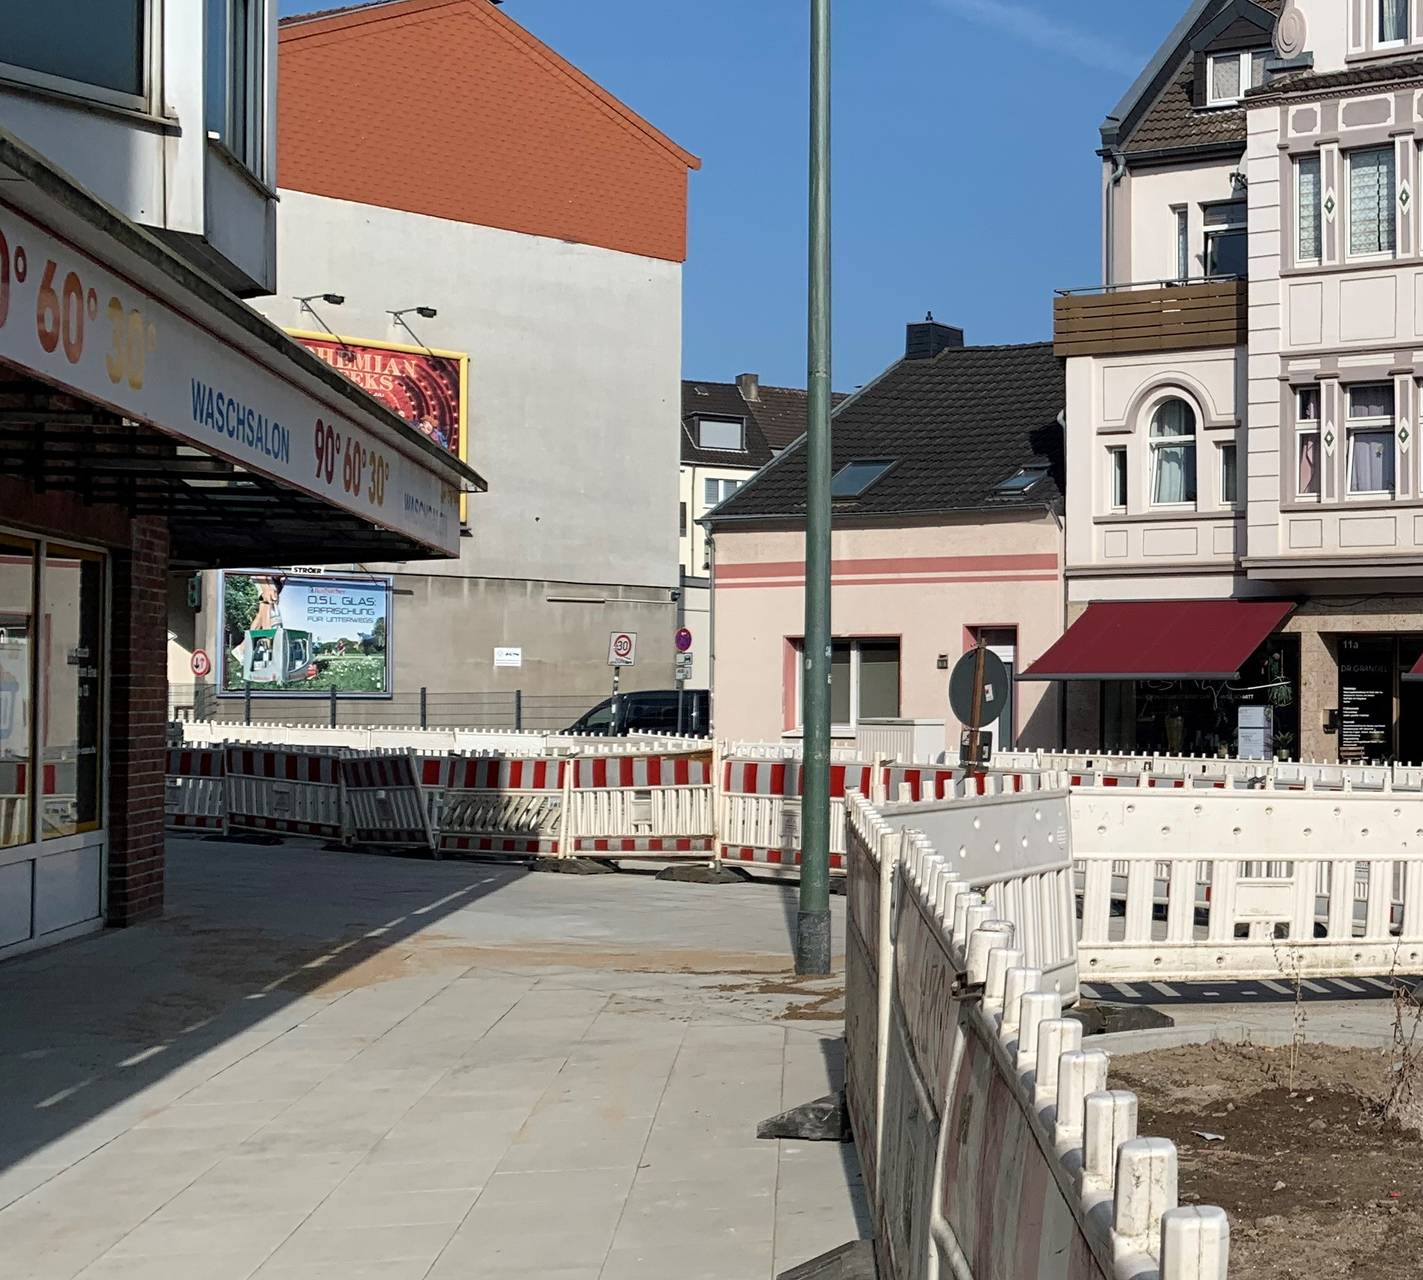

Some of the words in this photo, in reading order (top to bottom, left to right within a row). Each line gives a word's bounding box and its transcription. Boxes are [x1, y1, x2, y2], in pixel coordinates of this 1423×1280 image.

[36, 259, 98, 365] 60°
[191, 377, 290, 464] WASCHSALON
[314, 418, 341, 485] 90°
[343, 437, 367, 497] 60°
[367, 450, 390, 506] 30°
[307, 606, 376, 616] ERFRISCHUNG
[617, 640, 628, 651] 30
[1343, 640, 1359, 649] 11a
